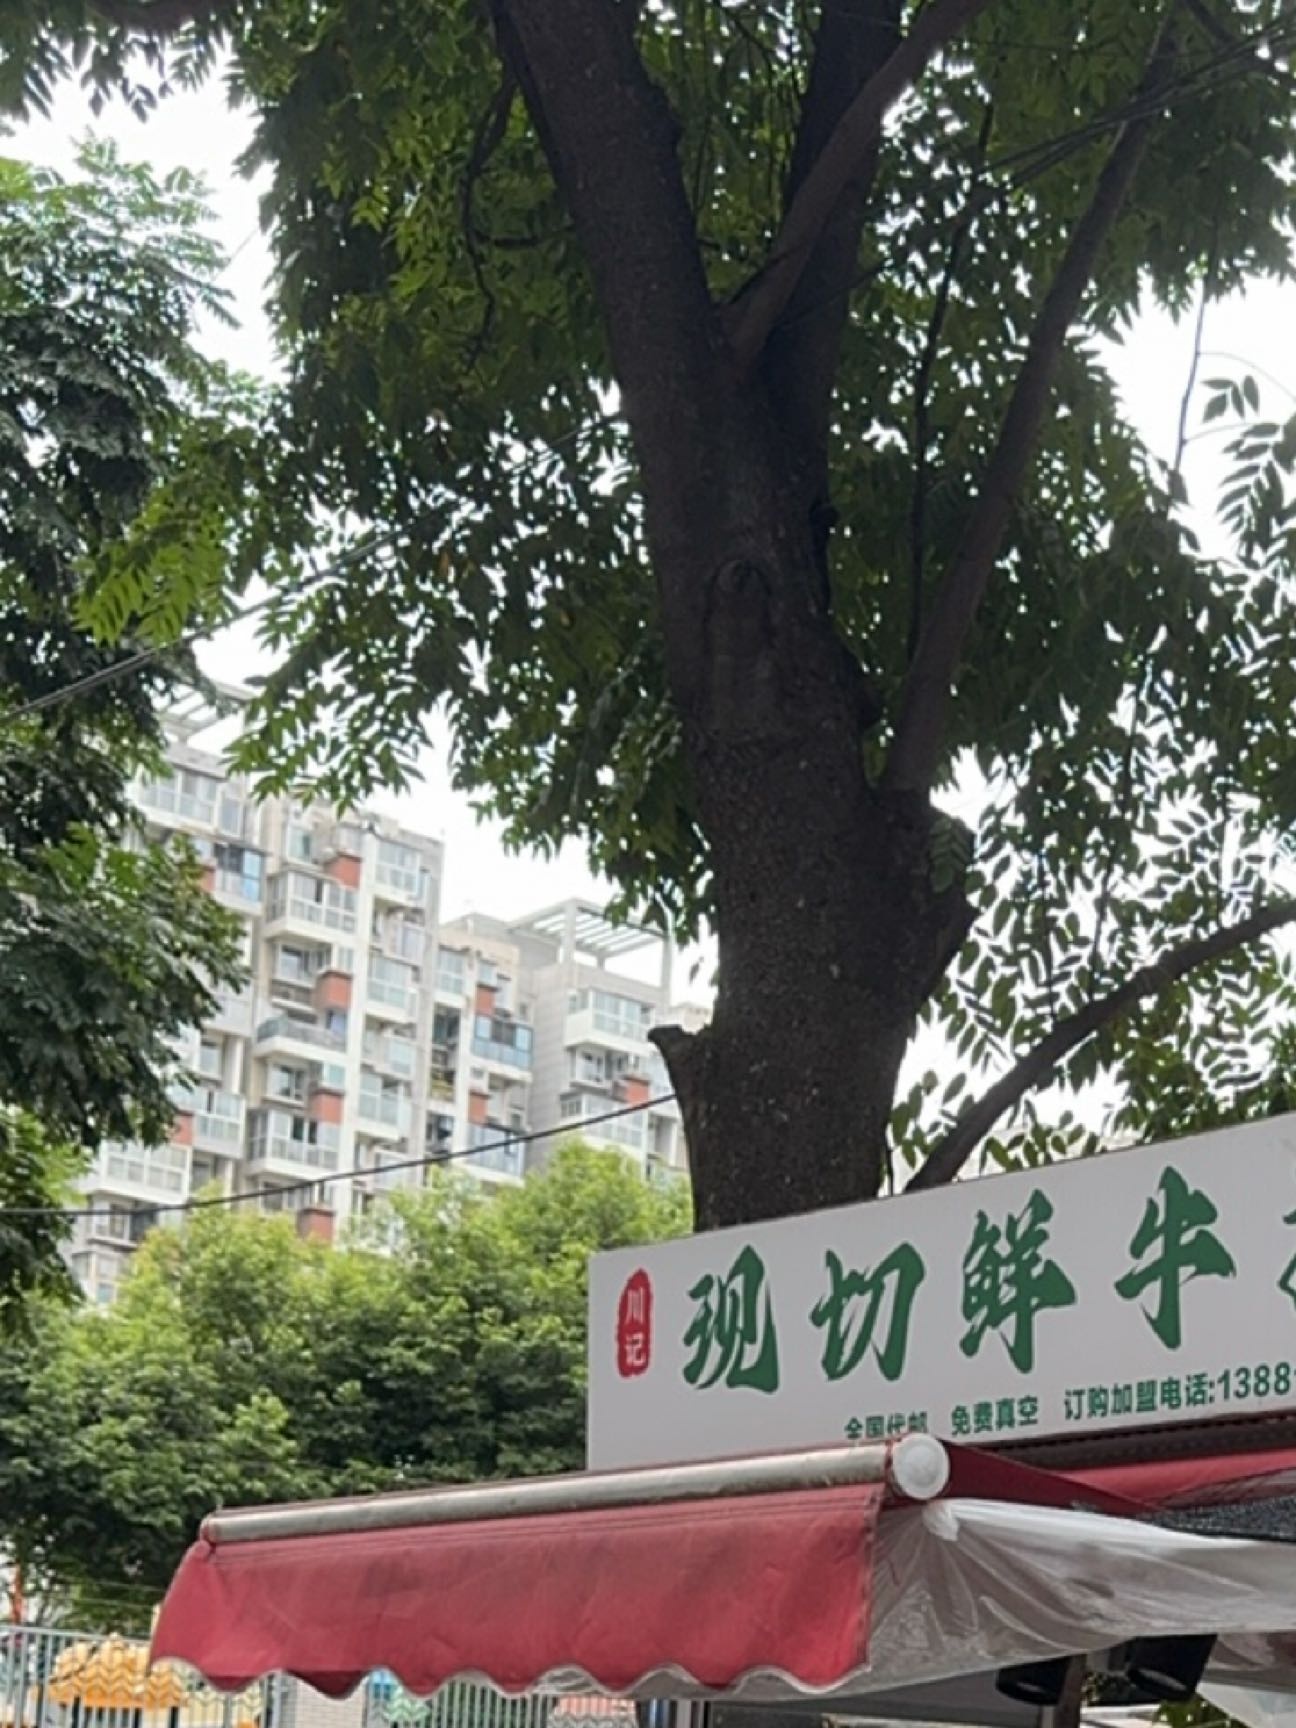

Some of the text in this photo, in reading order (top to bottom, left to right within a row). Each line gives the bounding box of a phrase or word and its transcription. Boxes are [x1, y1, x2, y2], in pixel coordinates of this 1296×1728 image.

[624, 1286, 646, 1367] 川记
[950, 1397, 1039, 1436] 免费真空
